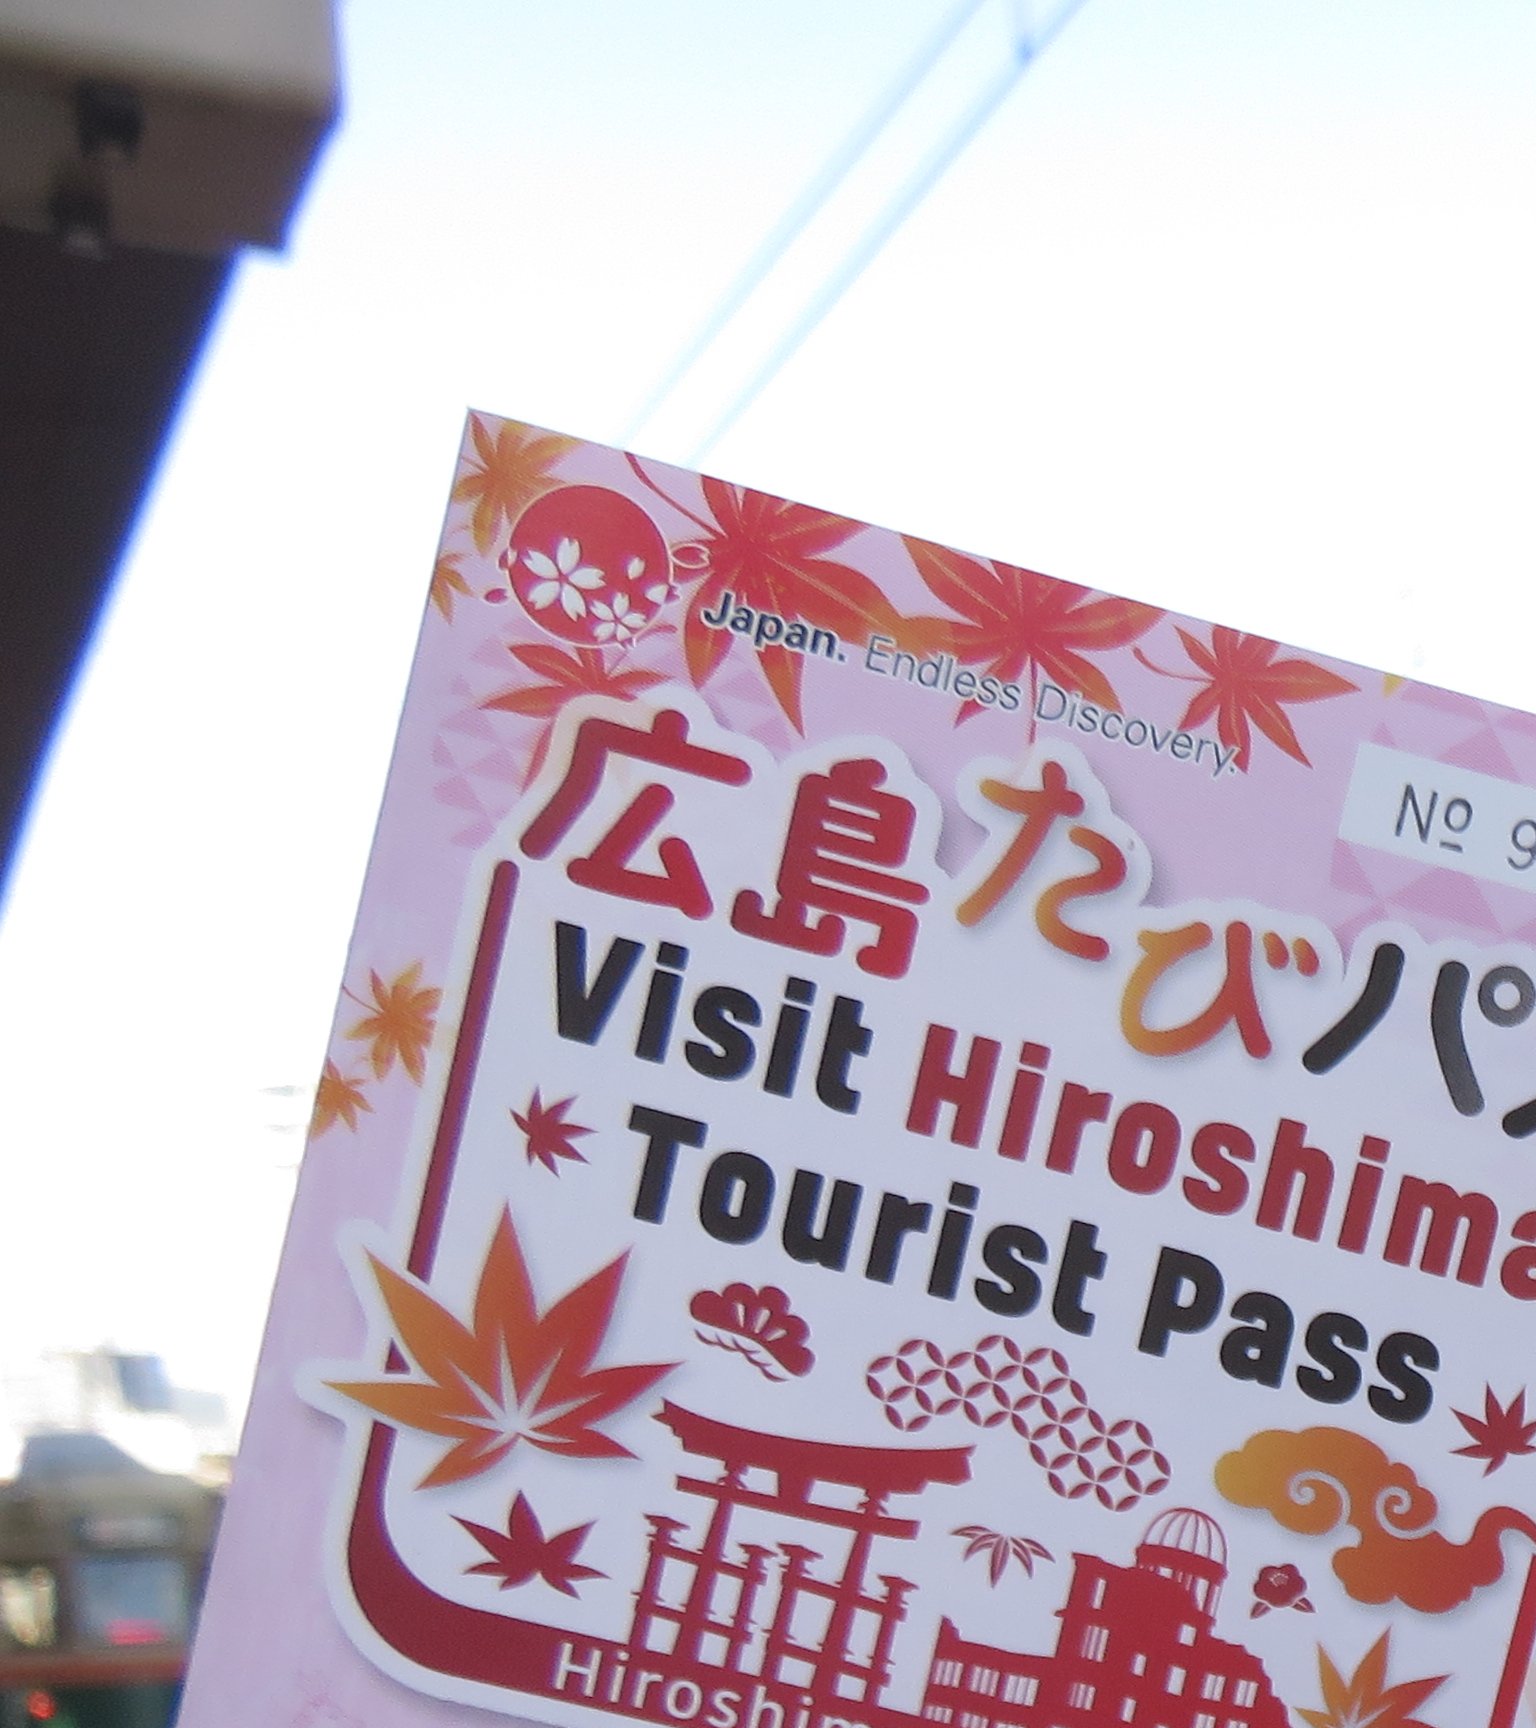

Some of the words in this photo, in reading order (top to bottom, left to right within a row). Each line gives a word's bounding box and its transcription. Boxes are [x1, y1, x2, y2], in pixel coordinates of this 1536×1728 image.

[702, 594, 847, 662] Japan.
[865, 636, 1020, 713] Endless
[1035, 683, 1241, 776] Discovery.
[553, 922, 873, 1114] Visit
[627, 1106, 1107, 1336] Tourist
[1138, 1247, 1440, 1423] Pass
